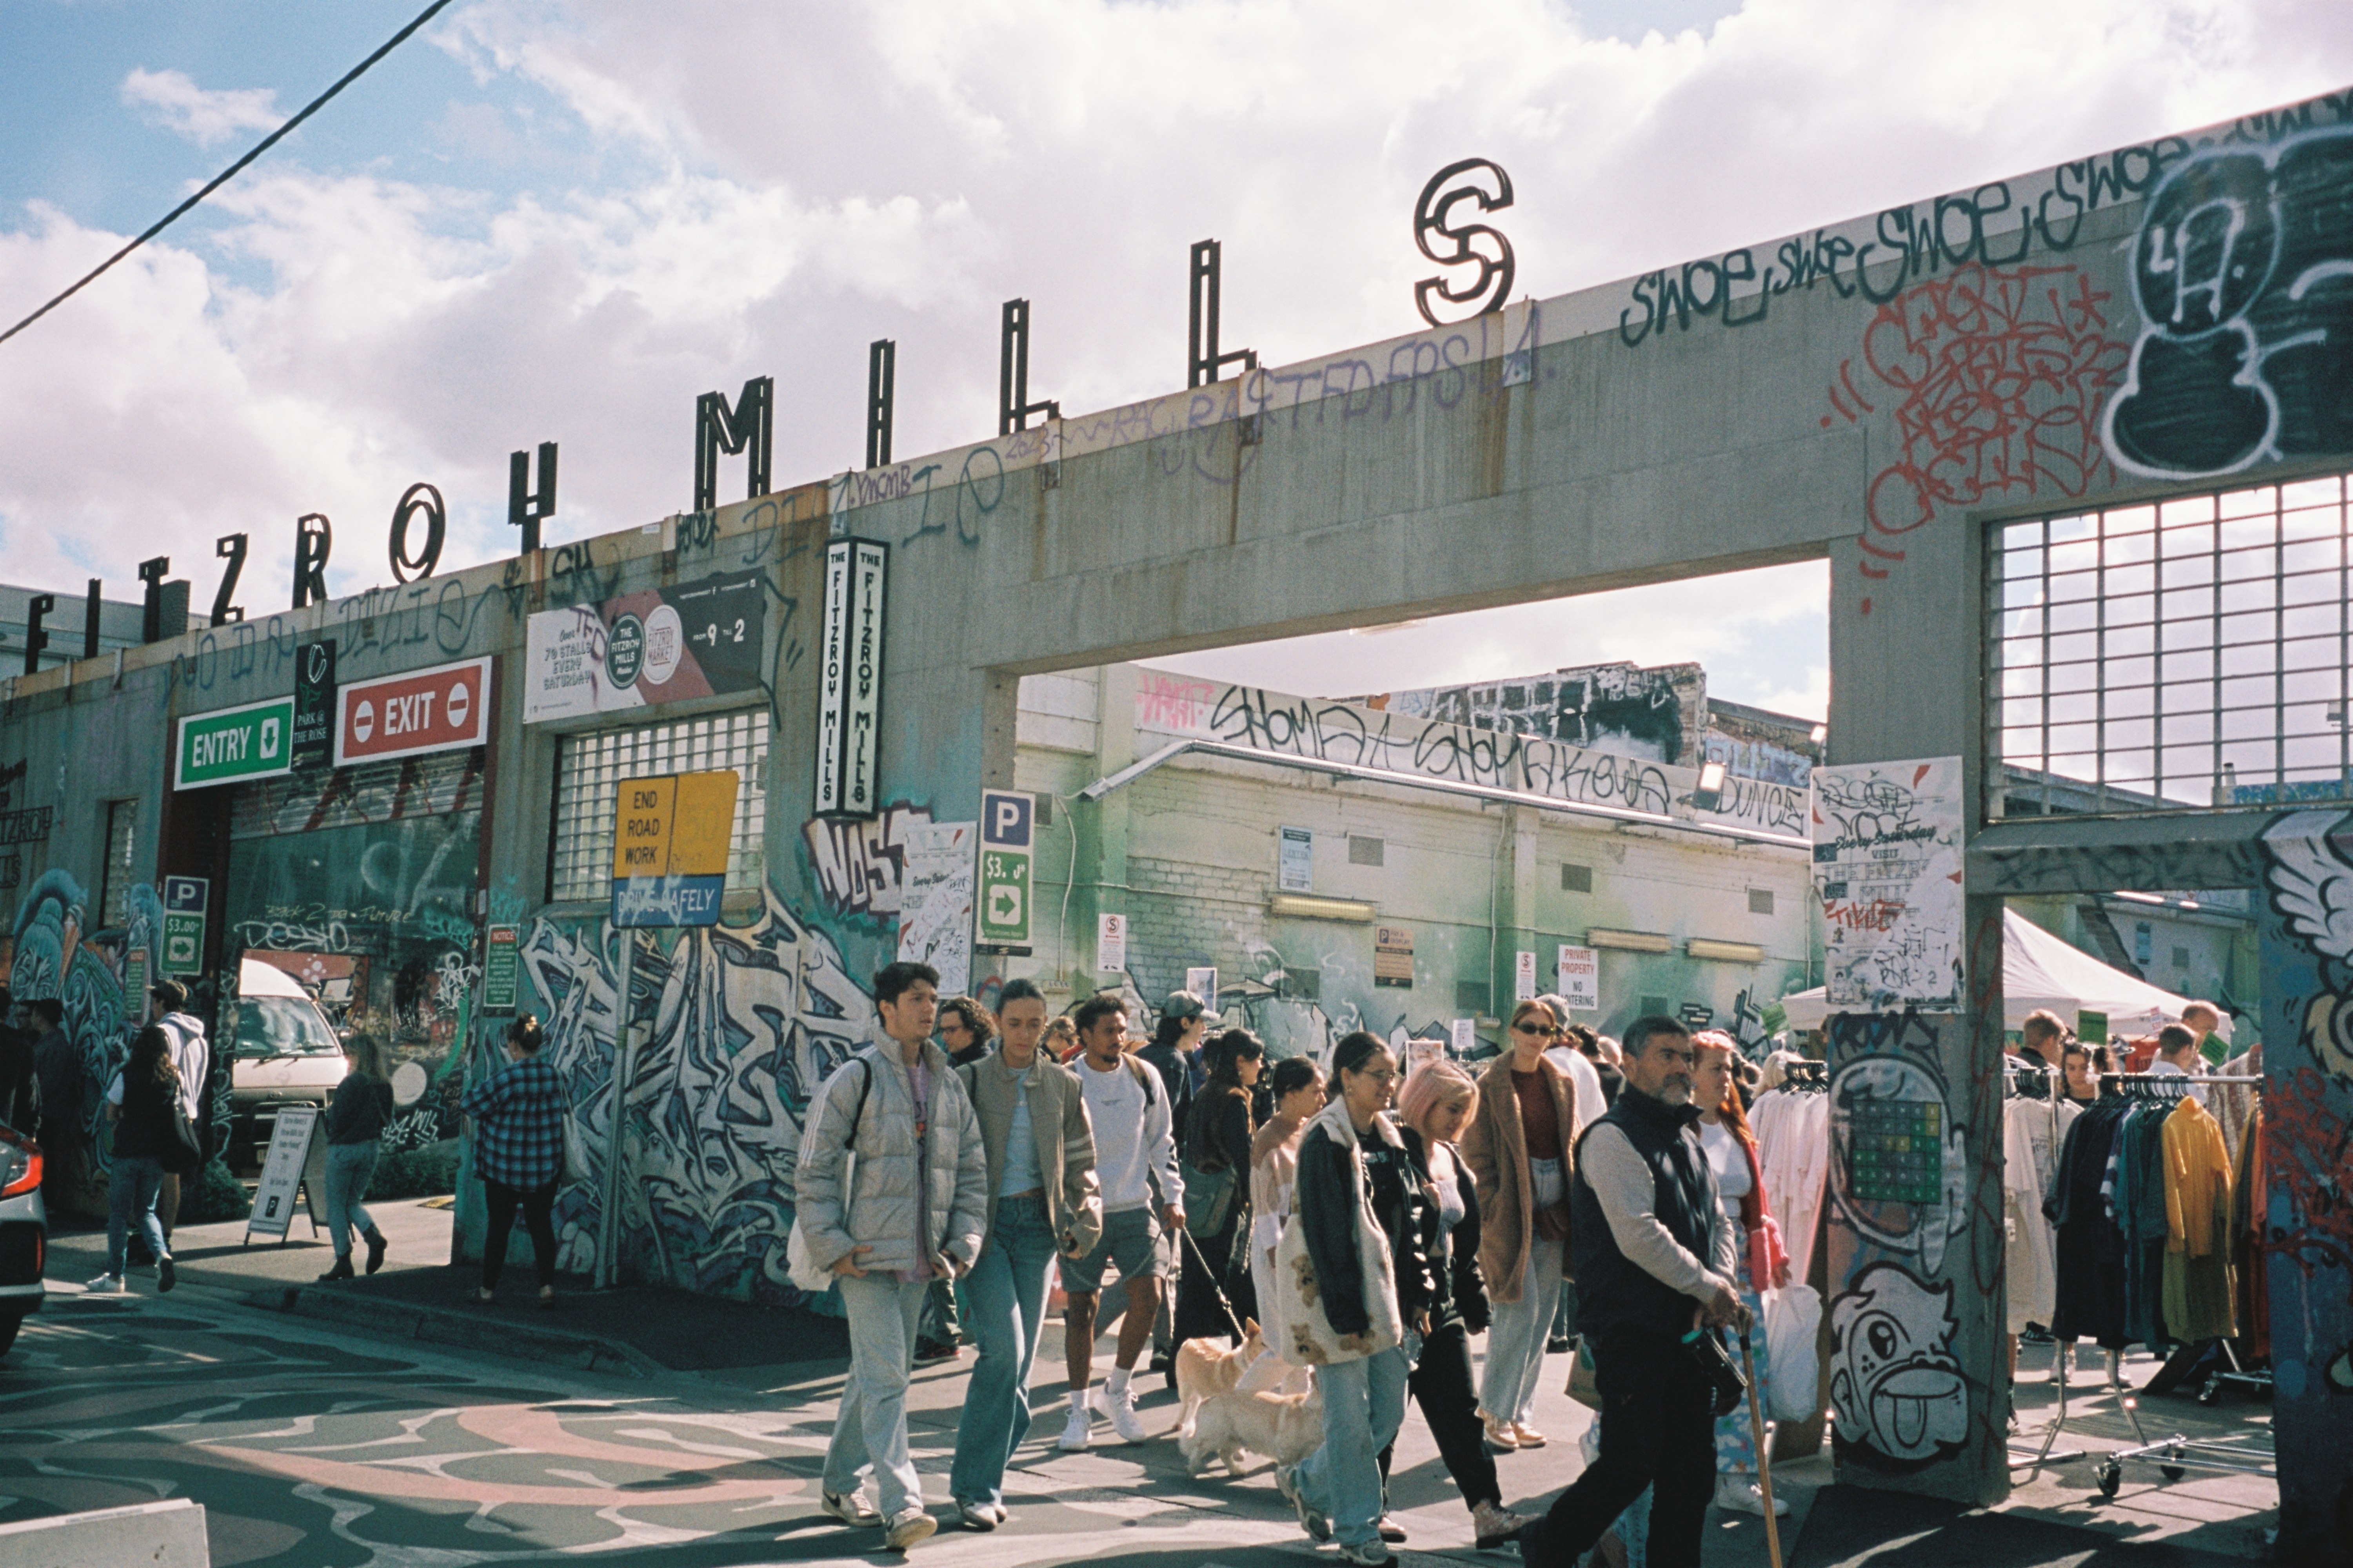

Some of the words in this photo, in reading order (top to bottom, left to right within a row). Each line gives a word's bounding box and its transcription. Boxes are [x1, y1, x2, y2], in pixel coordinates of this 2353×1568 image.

[24, 441, 558, 675] FITZROY
[694, 157, 1515, 512] MILLS
[830, 552, 845, 563] THE
[860, 553, 880, 566] THE
[620, 627, 632, 639] THE
[708, 623, 717, 646] 9
[734, 618, 745, 642] 2
[828, 571, 841, 697] FITZROY
[858, 572, 874, 701] FITZROY
[560, 641, 591, 658] STALLS
[611, 638, 640, 653] FITZROY
[553, 657, 581, 674] EVERY
[615, 652, 635, 664] MILLS
[544, 670, 591, 690] SATURDAY
[298, 713, 315, 725] PARK
[384, 691, 436, 735] EXIT
[294, 731, 306, 743] THE
[308, 728, 327, 741] ROSE
[193, 725, 251, 767] ENTRY
[823, 710, 836, 801] MILLS
[854, 712, 870, 803] MILLS
[633, 791, 658, 809] END
[627, 818, 660, 837] ROAD
[996, 801, 1019, 838] P
[1836, 835, 1872, 852] Every
[1874, 825, 1936, 845] Saturday
[625, 846, 658, 865] WORK
[1871, 849, 1899, 859] VISIT
[1822, 863, 1858, 882] THE
[178, 884, 196, 900] P
[618, 891, 654, 913] DRIVE
[661, 888, 716, 912] SAFELY
[493, 931, 514, 941] NOTICE
[1564, 949, 1591, 961] PRIVATE
[1561, 962, 1595, 975] PROPERTY
[1573, 981, 1583, 992] NO
